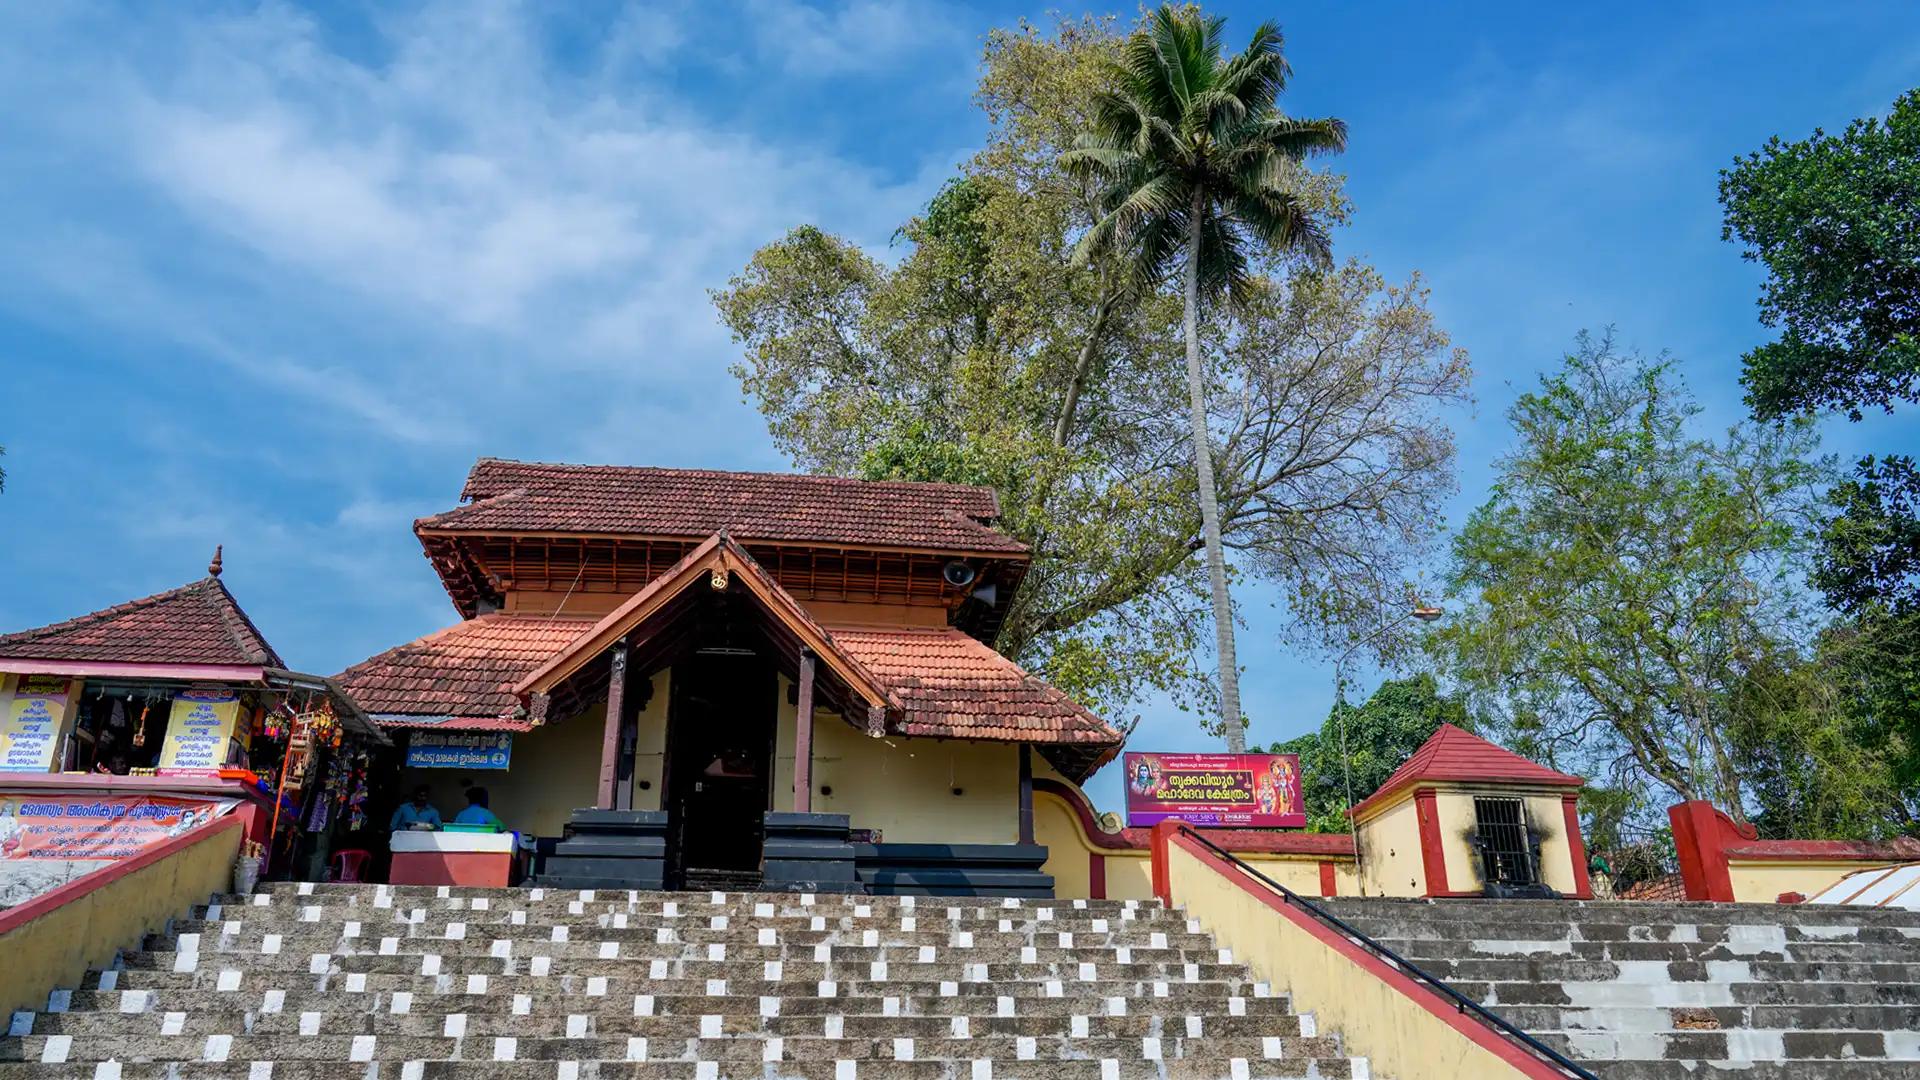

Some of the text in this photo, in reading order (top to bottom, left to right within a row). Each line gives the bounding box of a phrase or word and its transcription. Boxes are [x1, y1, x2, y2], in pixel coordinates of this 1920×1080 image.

[1169, 773, 1235, 789] തൃക്കവിയൂർ
[1156, 789, 1250, 802] മഹാദേവ ക്ഷേത്രം
[20, 803, 64, 817] ദേവസ്വം
[66, 802, 126, 820] അംഗീകൃത
